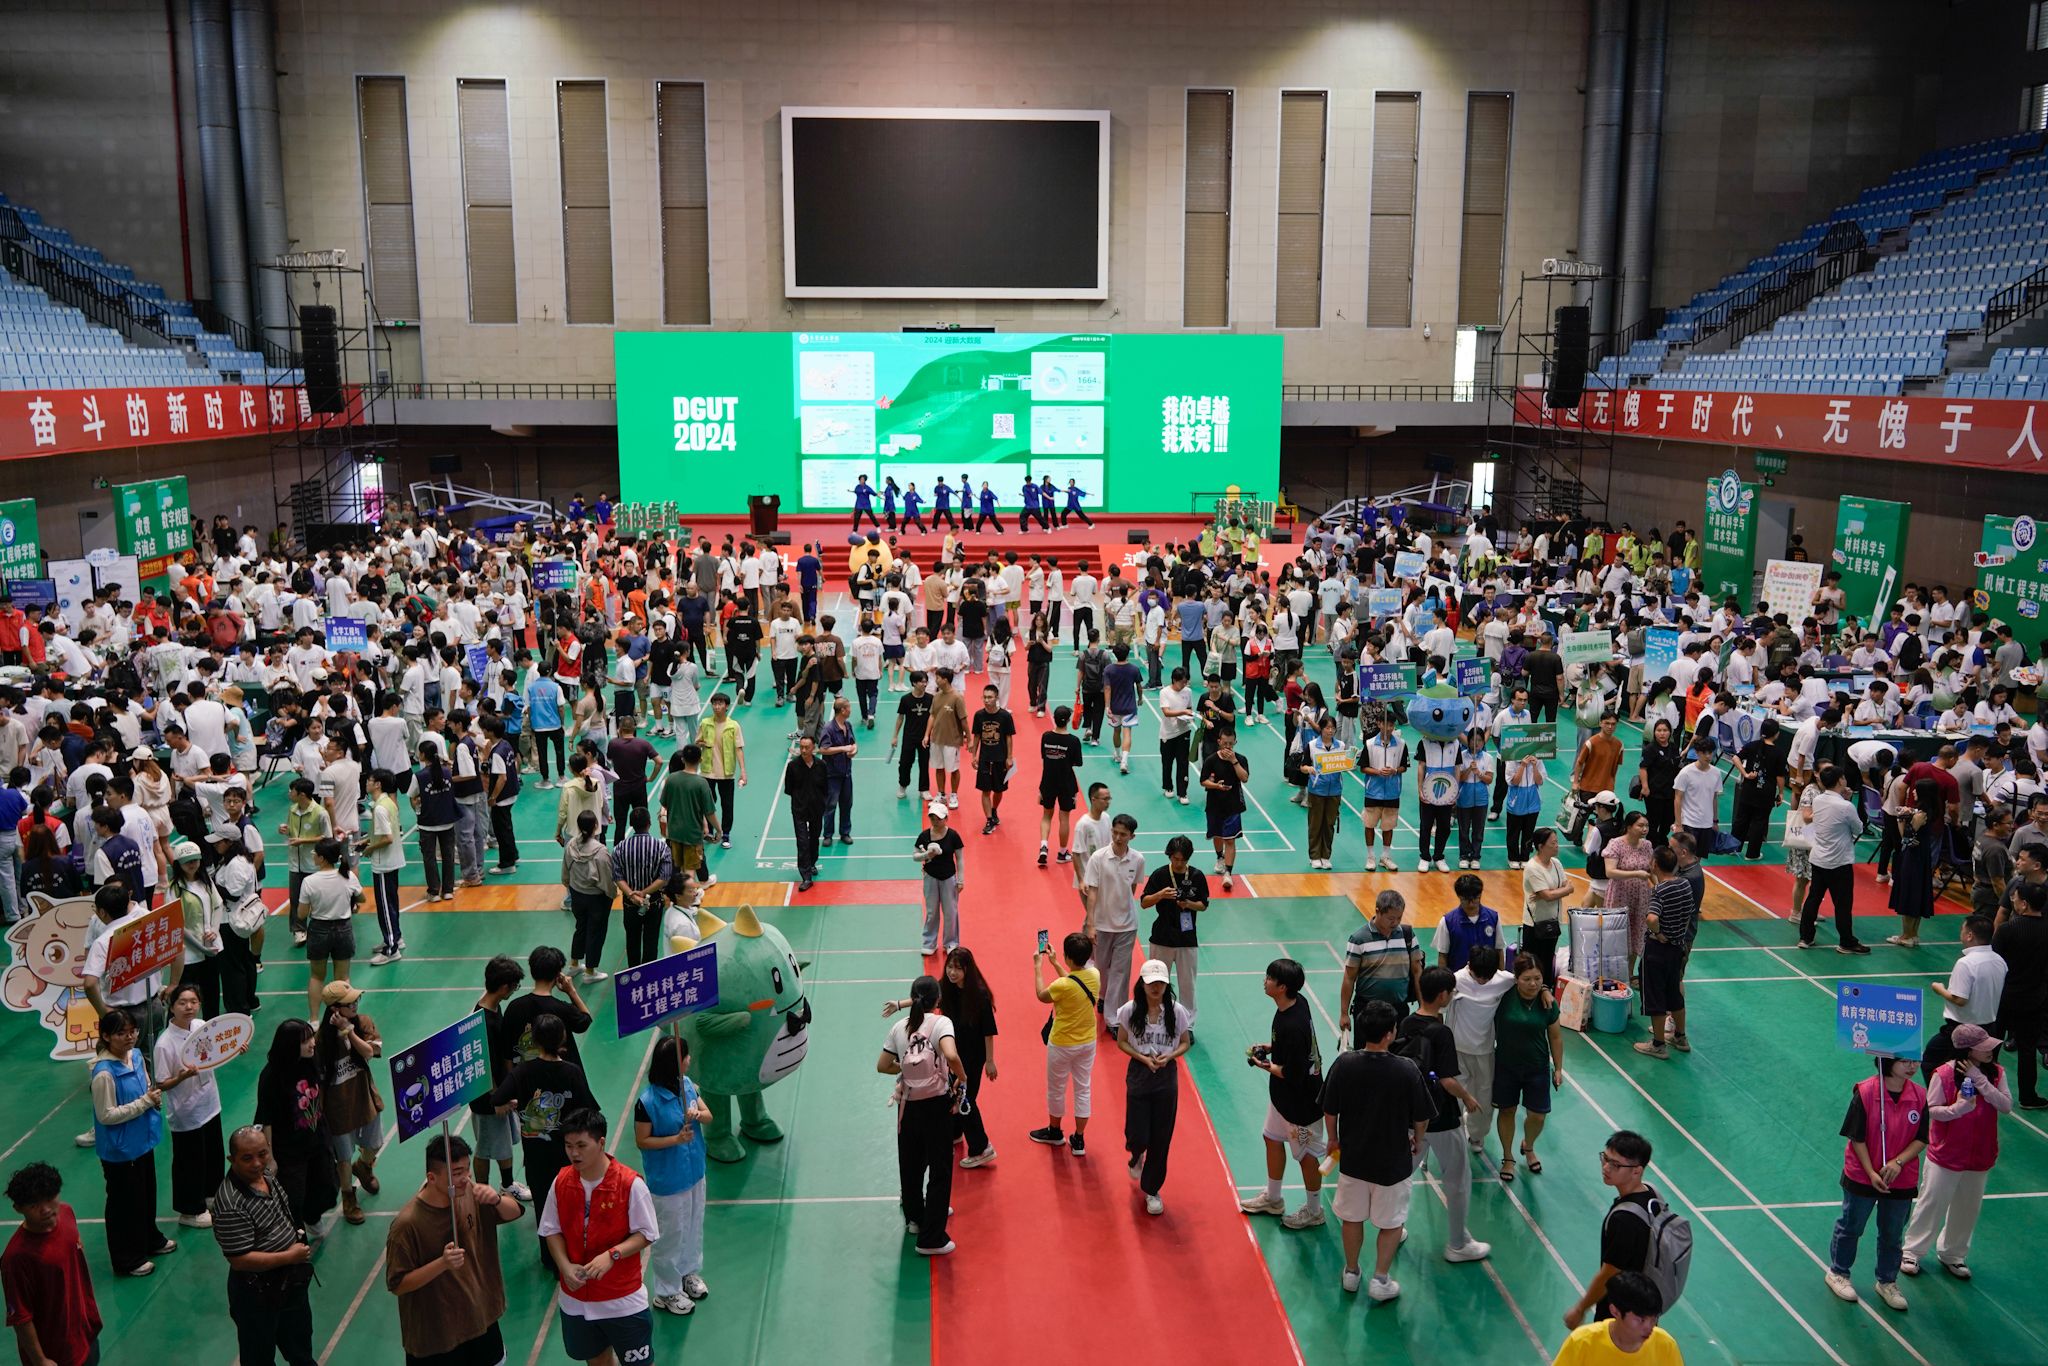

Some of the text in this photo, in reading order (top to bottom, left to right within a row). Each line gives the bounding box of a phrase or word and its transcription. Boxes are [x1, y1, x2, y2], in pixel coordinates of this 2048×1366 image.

[924, 336, 943, 344] 2024
[27, 387, 335, 447] 奋斗的新时代好青
[673, 396, 739, 421] DGUT
[1161, 395, 1231, 425] 我的卓越
[674, 422, 737, 451] 2024
[613, 499, 680, 529] 我的卓越
[1708, 513, 1745, 531] 计算机科学与
[135, 515, 151, 537] 收费
[1713, 528, 1738, 545] 技术学院
[166, 529, 188, 550] 服务点
[1844, 536, 1886, 558] 材料科学与
[1846, 556, 1880, 576] 工程学院
[1984, 573, 2048, 602] 机械工程学院
[332, 626, 361, 636] 化学工程与
[1566, 642, 1610, 653] 生命健康技术学院
[1372, 673, 1404, 682] 生态环境与
[1464, 667, 1484, 677] 生态环境与
[1369, 680, 1408, 690] 建筑工程学院
[132, 916, 169, 949] 文学与
[131, 927, 182, 967] 传媒学院
[631, 967, 704, 1004] 材料科学与
[640, 986, 699, 1020] 工程学院
[1842, 1005, 1917, 1027] 教育学院(师范学院)
[215, 1025, 241, 1042] 欢迎新
[220, 1038, 238, 1054] 同学
[430, 1039, 483, 1081] 电信工程与
[432, 1059, 486, 1103] 智能化学院
